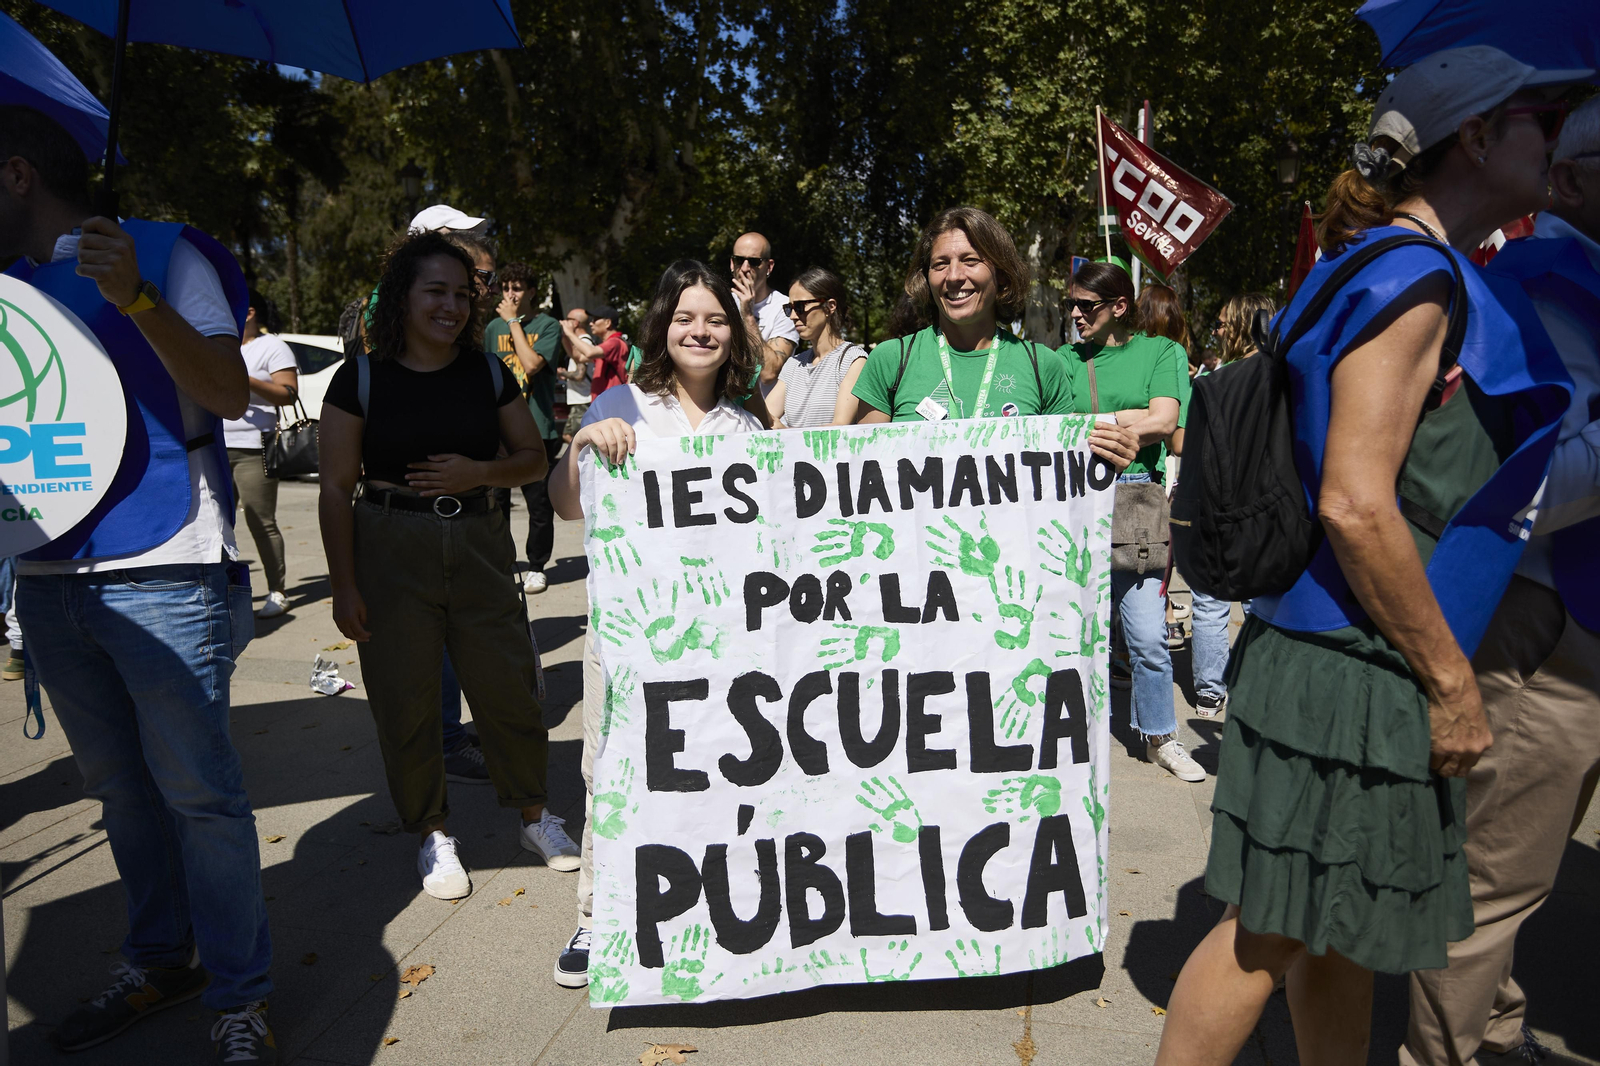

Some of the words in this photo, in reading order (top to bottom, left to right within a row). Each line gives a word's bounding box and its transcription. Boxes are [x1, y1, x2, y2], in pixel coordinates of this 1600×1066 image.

[1127, 210, 1175, 259] Sevilla
[986, 353, 996, 371] USTEA
[976, 389, 987, 408] USTEA
[0, 481, 93, 496] ENDIENTE
[642, 462, 759, 528] IES
[793, 450, 1115, 518] DIAMANTINO
[743, 569, 852, 631] POR
[879, 570, 960, 624] LA
[643, 668, 1090, 792] ESCUELA
[635, 804, 1087, 968] PÚBLICA
